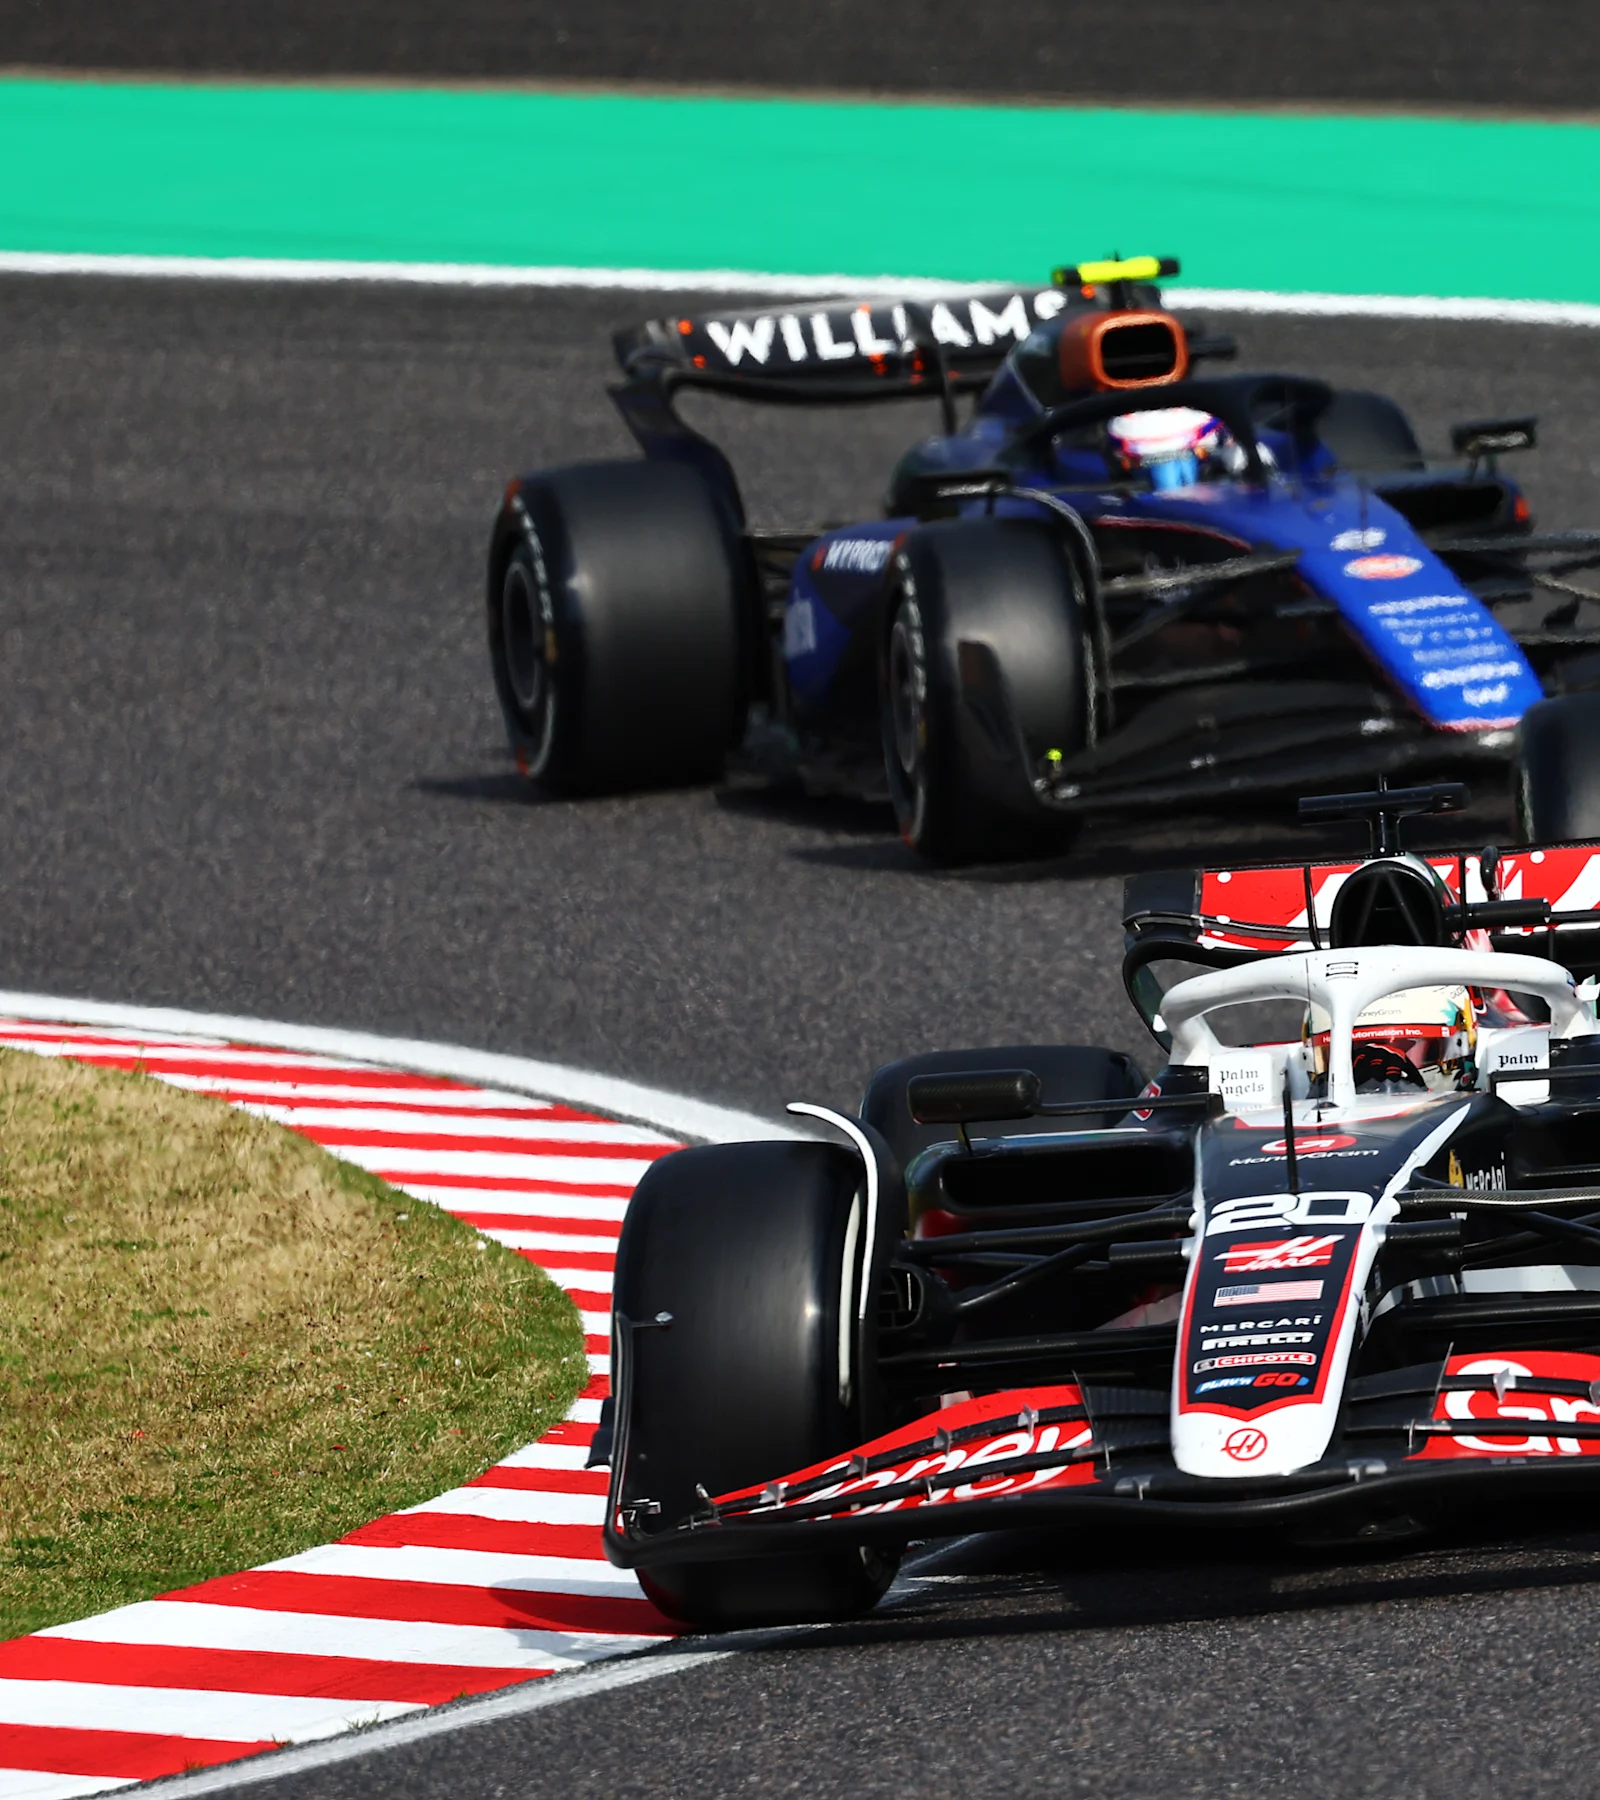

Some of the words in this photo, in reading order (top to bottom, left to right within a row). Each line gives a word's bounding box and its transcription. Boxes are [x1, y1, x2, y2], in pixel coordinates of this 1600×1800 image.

[1352, 1030, 1403, 1038] utomation
[1498, 1055, 1539, 1068] Palm
[1220, 1069, 1258, 1083] Palm
[1205, 1191, 1373, 1237] 20
[1202, 1332, 1314, 1350] PIRELLI
[1221, 1353, 1310, 1365] CHIPOTLE
[1252, 1372, 1301, 1387] GO
